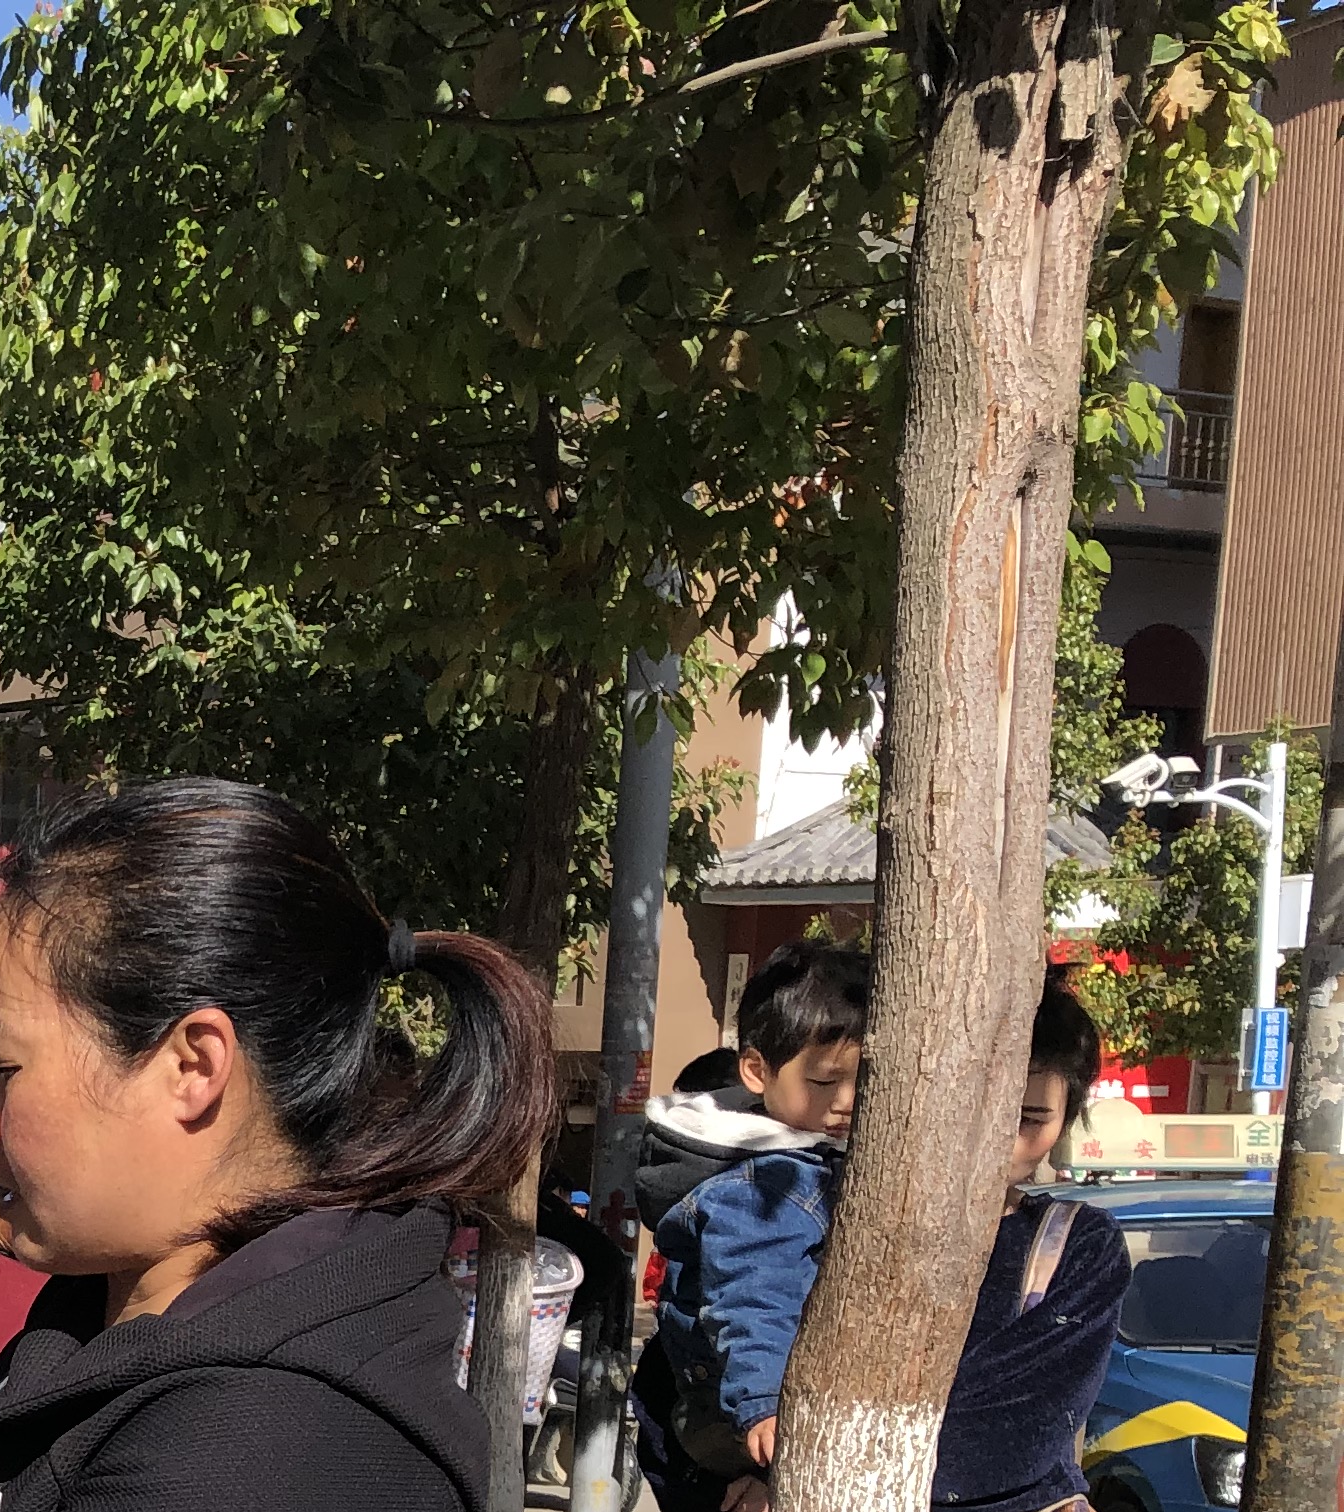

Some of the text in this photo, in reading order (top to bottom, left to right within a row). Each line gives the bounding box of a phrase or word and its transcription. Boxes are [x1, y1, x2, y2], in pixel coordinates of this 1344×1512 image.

[1261, 1012, 1281, 1085] 视频监控区域
